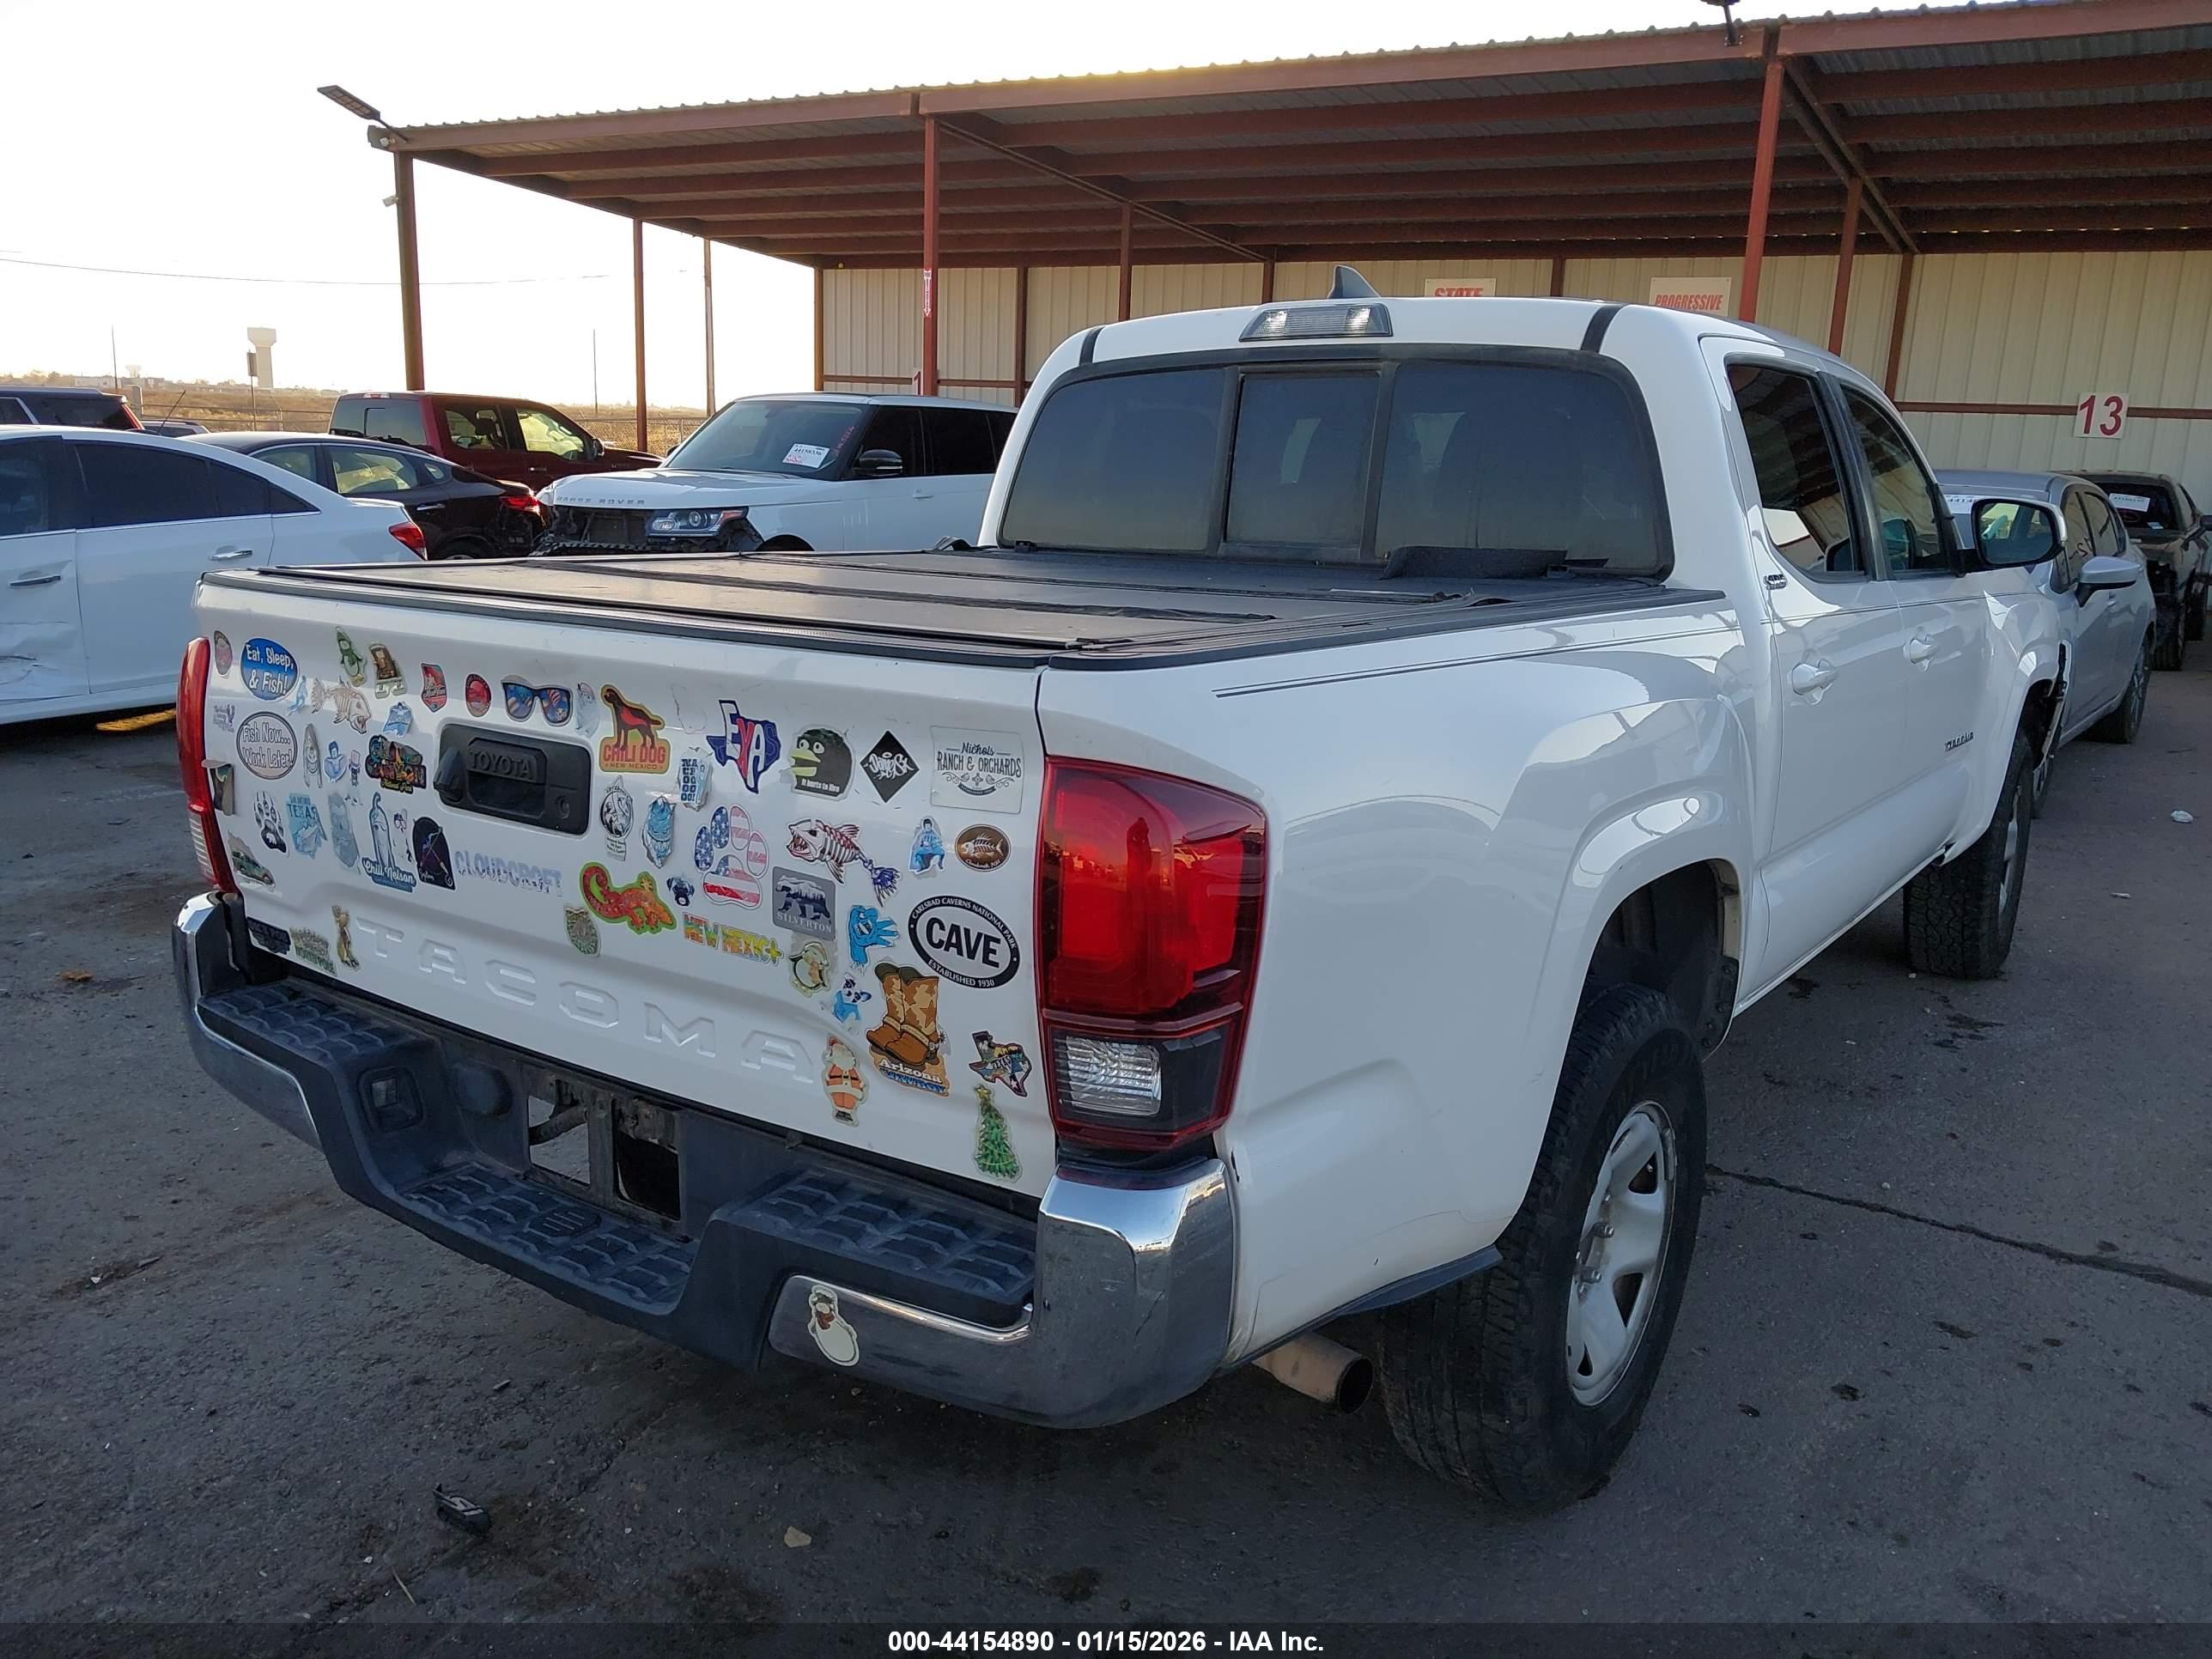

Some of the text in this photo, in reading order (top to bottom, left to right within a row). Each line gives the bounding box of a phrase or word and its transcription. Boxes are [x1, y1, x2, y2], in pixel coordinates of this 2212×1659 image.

[1656, 294, 1723, 310] PROGRESSIVE
[2079, 395, 2124, 435] 13
[246, 644, 294, 672] Eat, Sleep,
[249, 669, 288, 695] & Fish!
[242, 721, 290, 745] Fish Now...
[706, 702, 781, 787] TEXAS
[242, 747, 293, 769] Work Later!
[604, 744, 666, 763] CHILI DOG
[961, 741, 994, 757] Nichols
[470, 750, 534, 780] TOYOTA
[937, 750, 1022, 778] RANCH & ORCHARDS
[683, 912, 720, 950] NEW
[777, 911, 832, 933] SILVERTON
[912, 897, 1018, 949] CARLSBAD CAVERNS NATIONAL PARK
[926, 916, 1001, 969] CAVE
[928, 959, 995, 988] ESTABLISHED 1930
[356, 916, 815, 1084] TACOMA
[879, 1059, 943, 1083] Arizona
